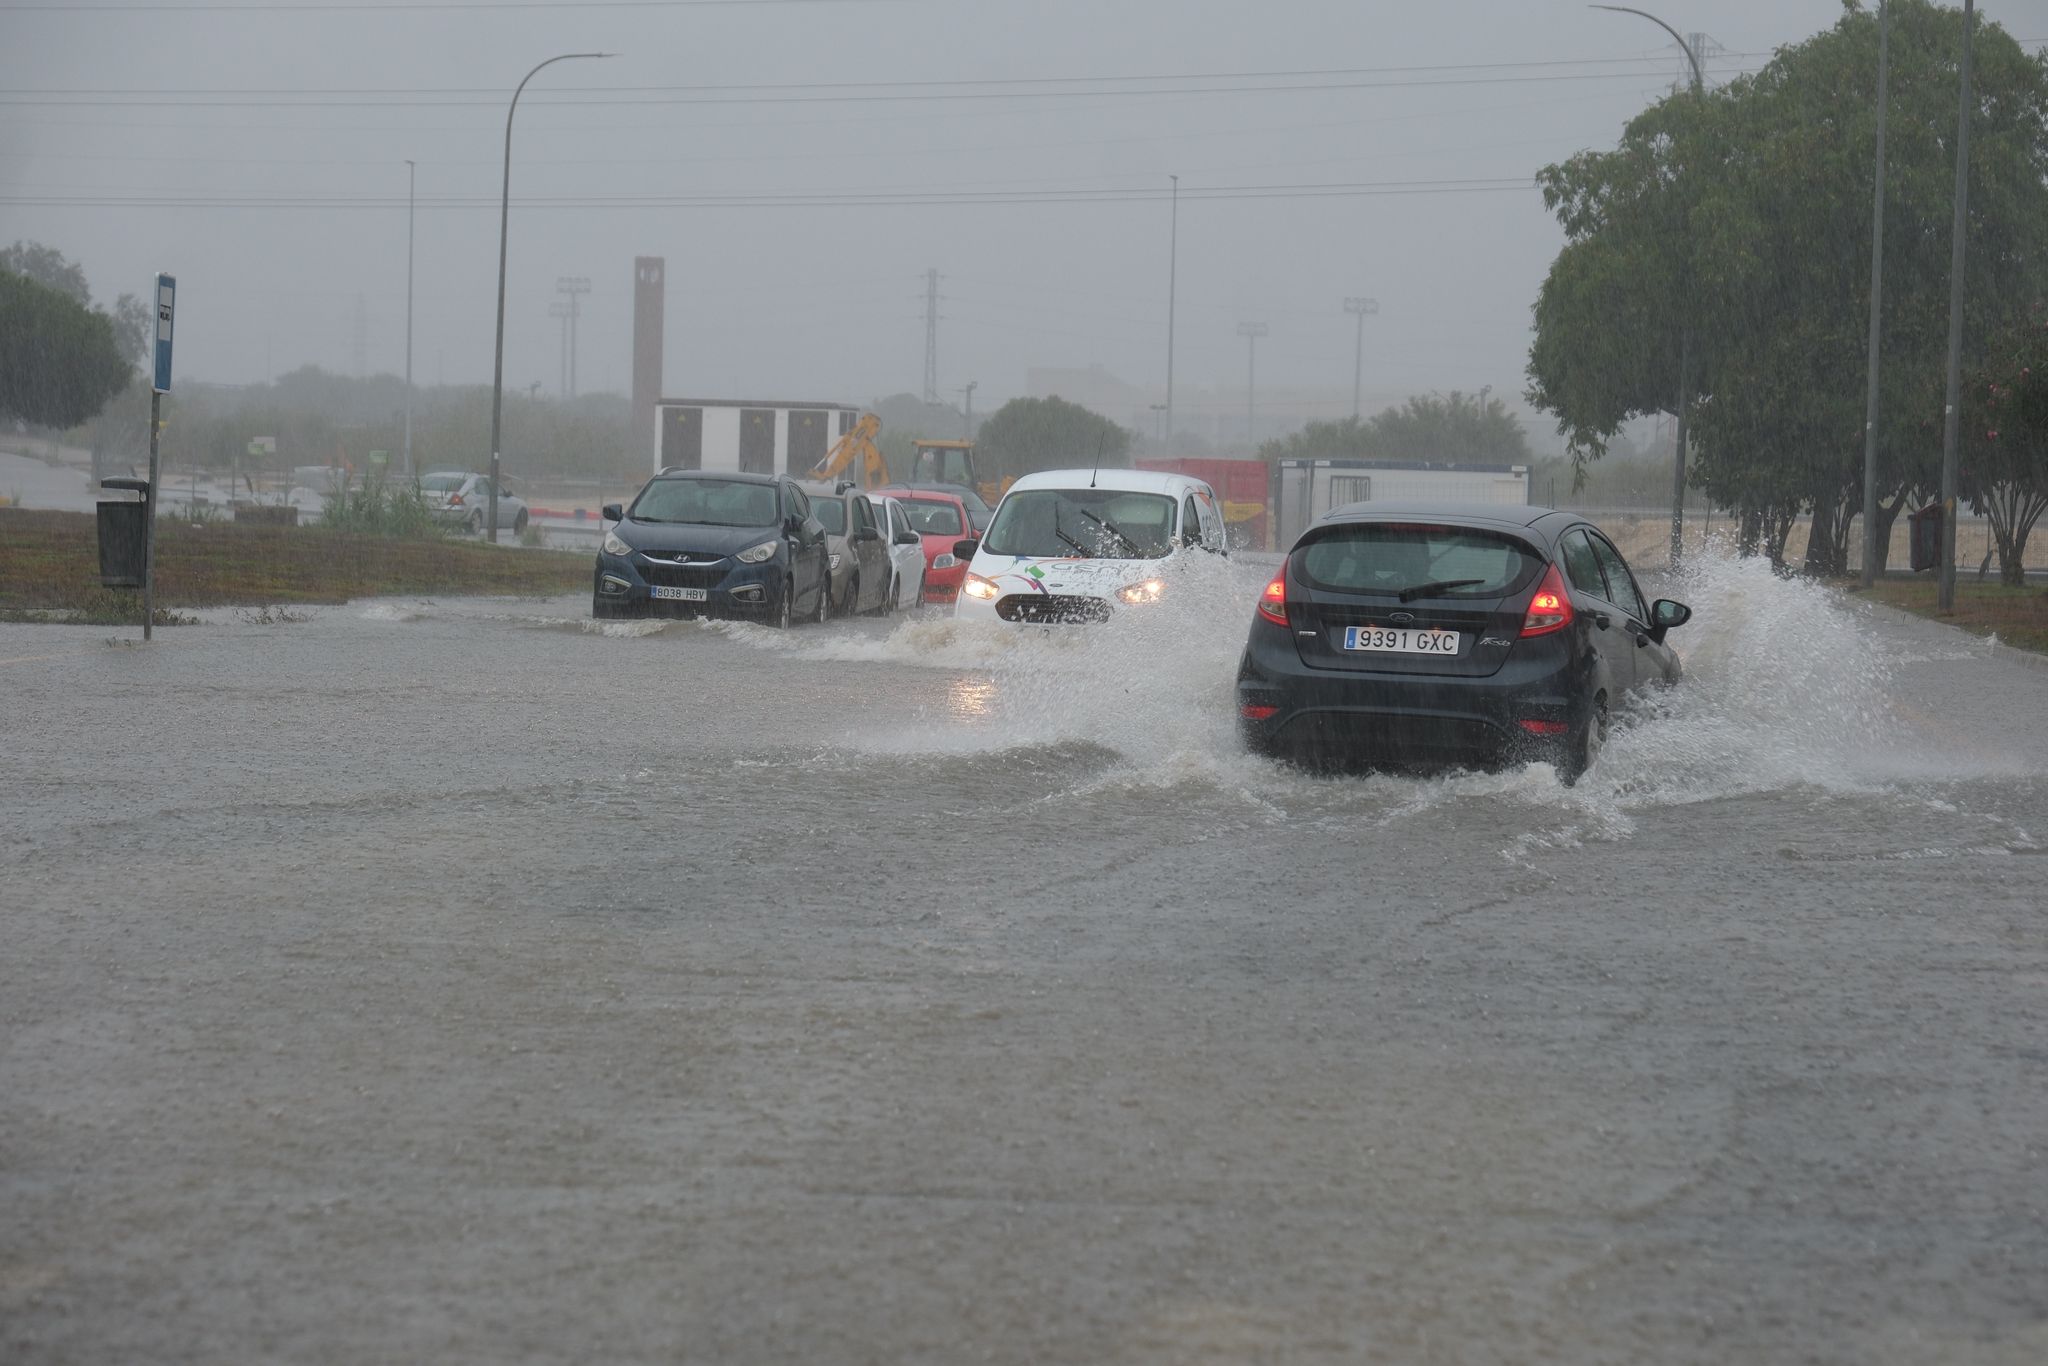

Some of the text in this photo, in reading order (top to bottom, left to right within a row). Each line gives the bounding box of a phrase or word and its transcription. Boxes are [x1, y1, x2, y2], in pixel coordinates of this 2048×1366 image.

[657, 587, 705, 600] 8038 HBV
[1360, 630, 1455, 652] 9391 GXC
